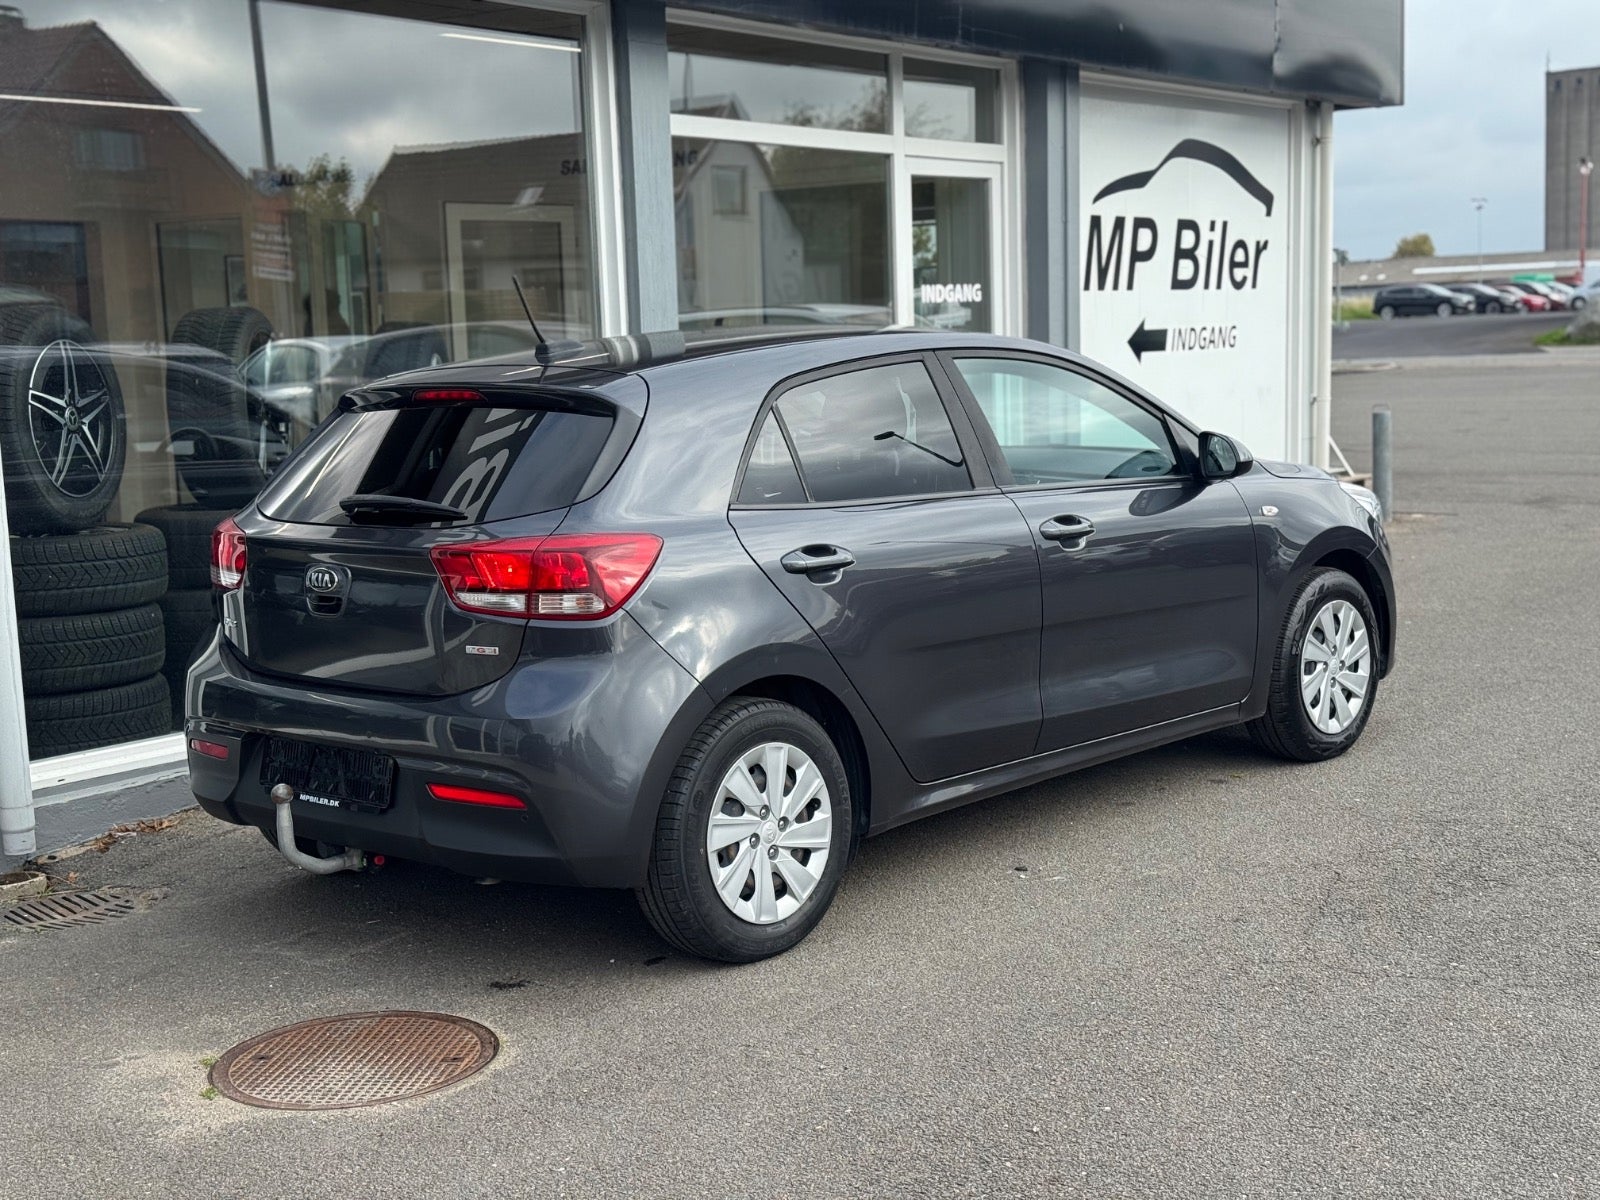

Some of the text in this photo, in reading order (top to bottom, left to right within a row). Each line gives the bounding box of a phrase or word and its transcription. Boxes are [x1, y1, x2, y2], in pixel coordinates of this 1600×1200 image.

[1083, 215, 1269, 291] MP Biler
[921, 283, 982, 303] INDGANG
[1171, 325, 1237, 352] INDGANG
[310, 572, 332, 587] KIA
[299, 793, 340, 807] MPBILER.DK
